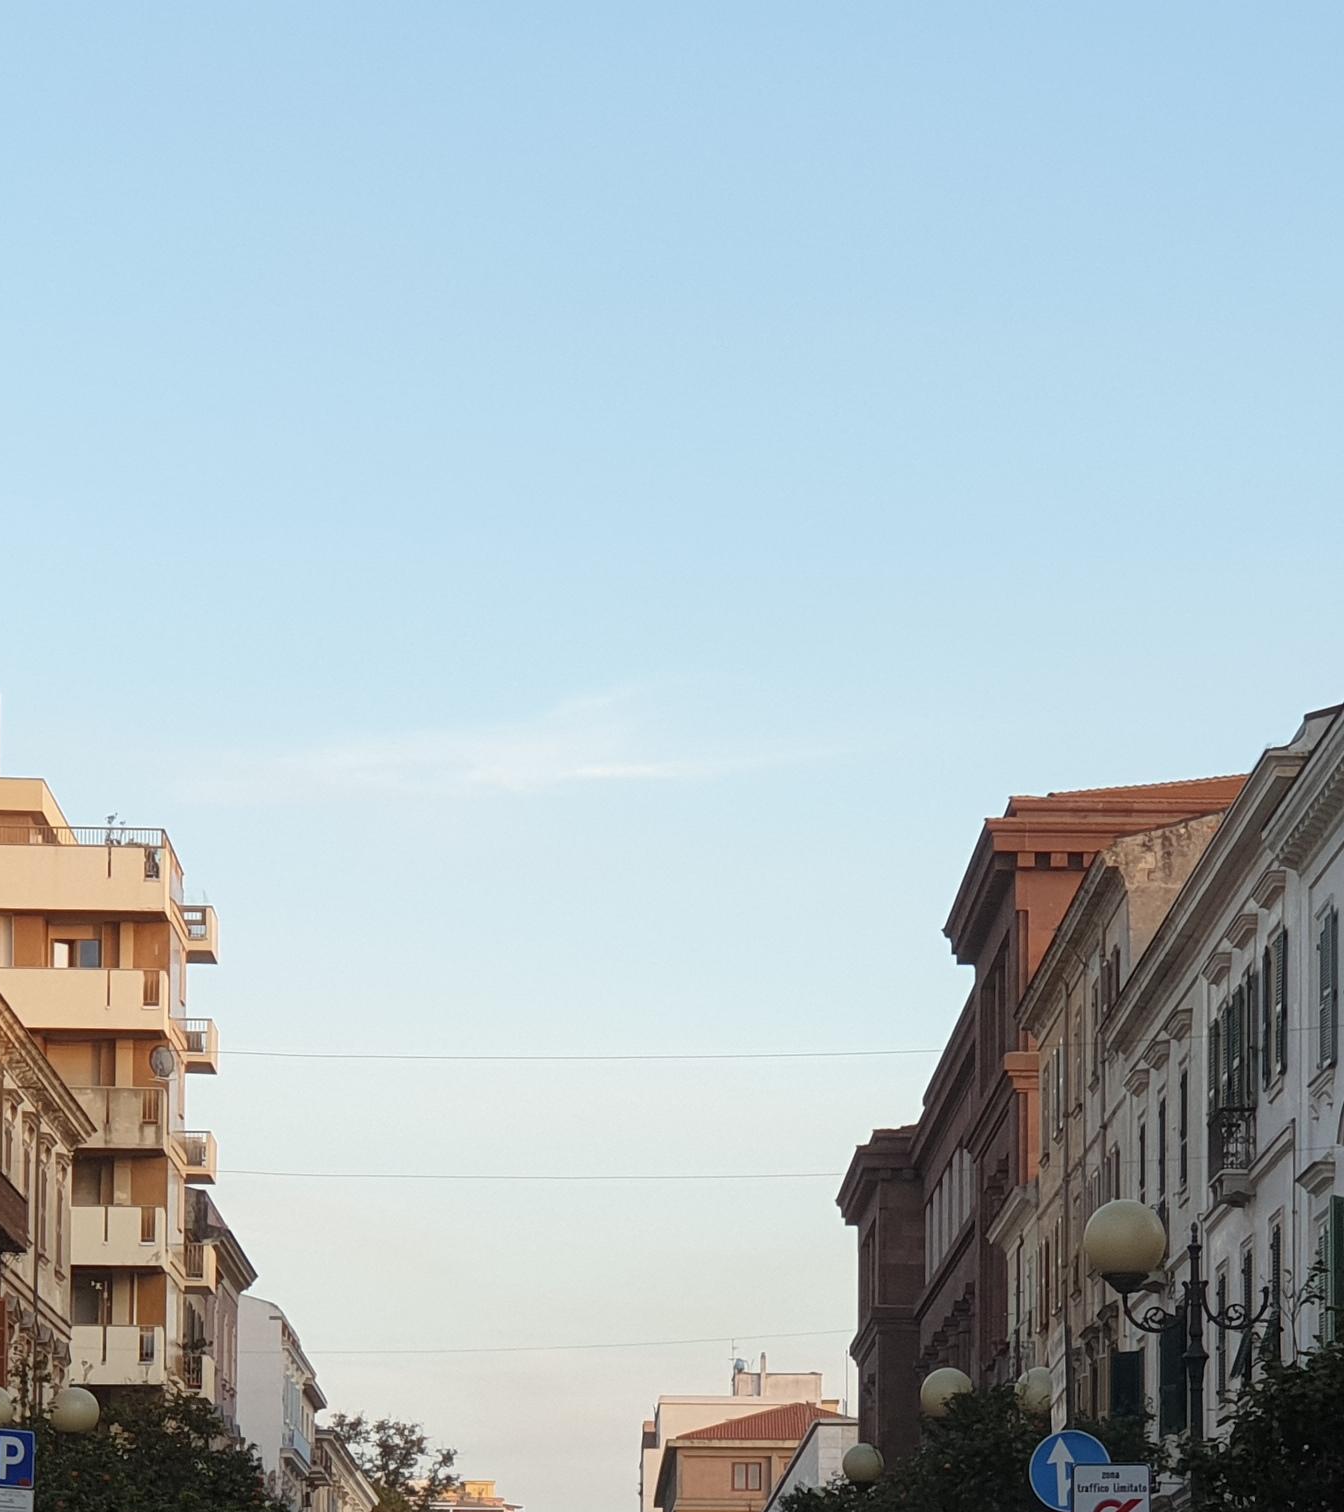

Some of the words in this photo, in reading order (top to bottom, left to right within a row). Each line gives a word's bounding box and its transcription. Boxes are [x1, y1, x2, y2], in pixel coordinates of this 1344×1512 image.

[1101, 1471, 1120, 1480] zona
[1077, 1482, 1110, 1493] traffico
[1113, 1482, 1148, 1493] limitato
